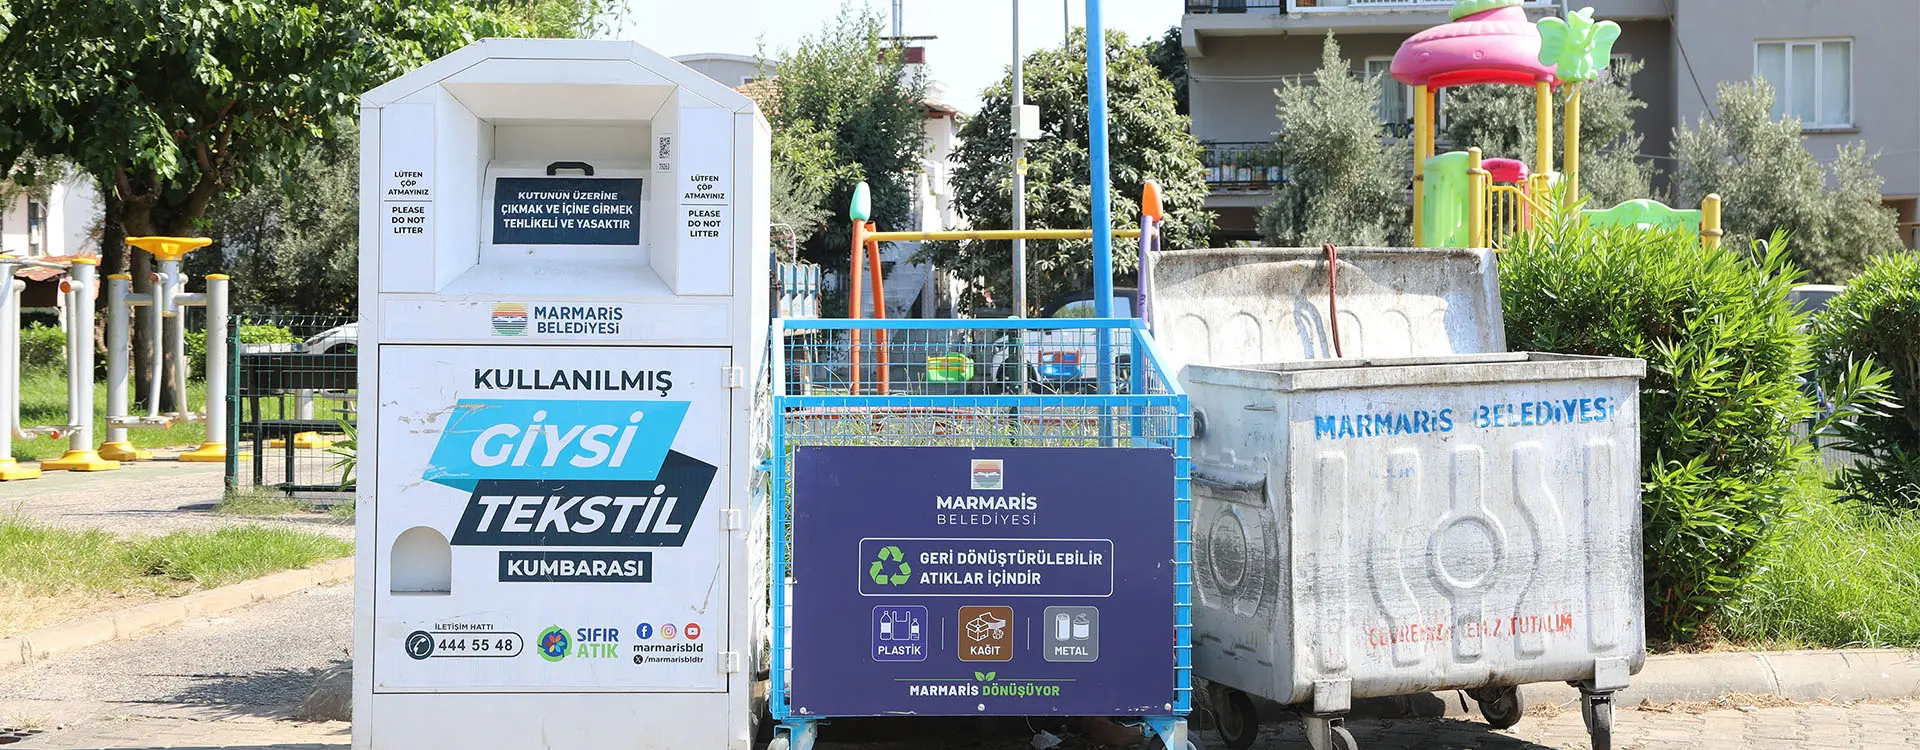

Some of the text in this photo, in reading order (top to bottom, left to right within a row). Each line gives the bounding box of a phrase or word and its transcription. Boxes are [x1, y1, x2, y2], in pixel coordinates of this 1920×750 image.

[394, 170, 423, 178] LÜTFEN
[690, 174, 719, 182] LÜTFEN
[400, 179, 417, 188] ÇÖP
[696, 183, 713, 192] ÇÖP
[518, 190, 618, 200] KUTUNUN ÜZERİNE
[392, 206, 425, 214] PLEASE
[501, 202, 633, 216] ÇIKMAK VE İÇİNE GİRMEK
[688, 210, 721, 218] PLEASE
[391, 216, 425, 224] DO NOT
[503, 216, 630, 229] TEHLİKELİ VE YASAKTIR
[688, 220, 721, 228] DO NOT
[394, 226, 424, 234] LITTER
[690, 230, 719, 238] LITTER
[473, 368, 673, 397] KULLANILMIŞ
[470, 410, 643, 468] GİYSİ
[936, 492, 1038, 510] MARMARİS
[476, 484, 683, 534] TEKSTİL
[937, 512, 1037, 525] BELEDİYESİ
[919, 550, 1103, 569] GERİ DÖNÜŞTÜRÜLEBİLİR
[507, 559, 644, 577] KUMBARASI
[919, 571, 1041, 588] ATIKLAR İÇİNDİR
[434, 622, 468, 631] İLETİŞİM
[576, 628, 619, 642] SIFIR
[438, 639, 513, 651] 444 55 48
[576, 643, 619, 658] ATIK
[633, 643, 704, 653] marmarisbld
[878, 643, 921, 656] PLASTİK
[970, 643, 1001, 656] KAĞIT
[1054, 646, 1089, 656] METAL
[909, 682, 1060, 699] MARMARİS DÖNÜŞÜYOR
